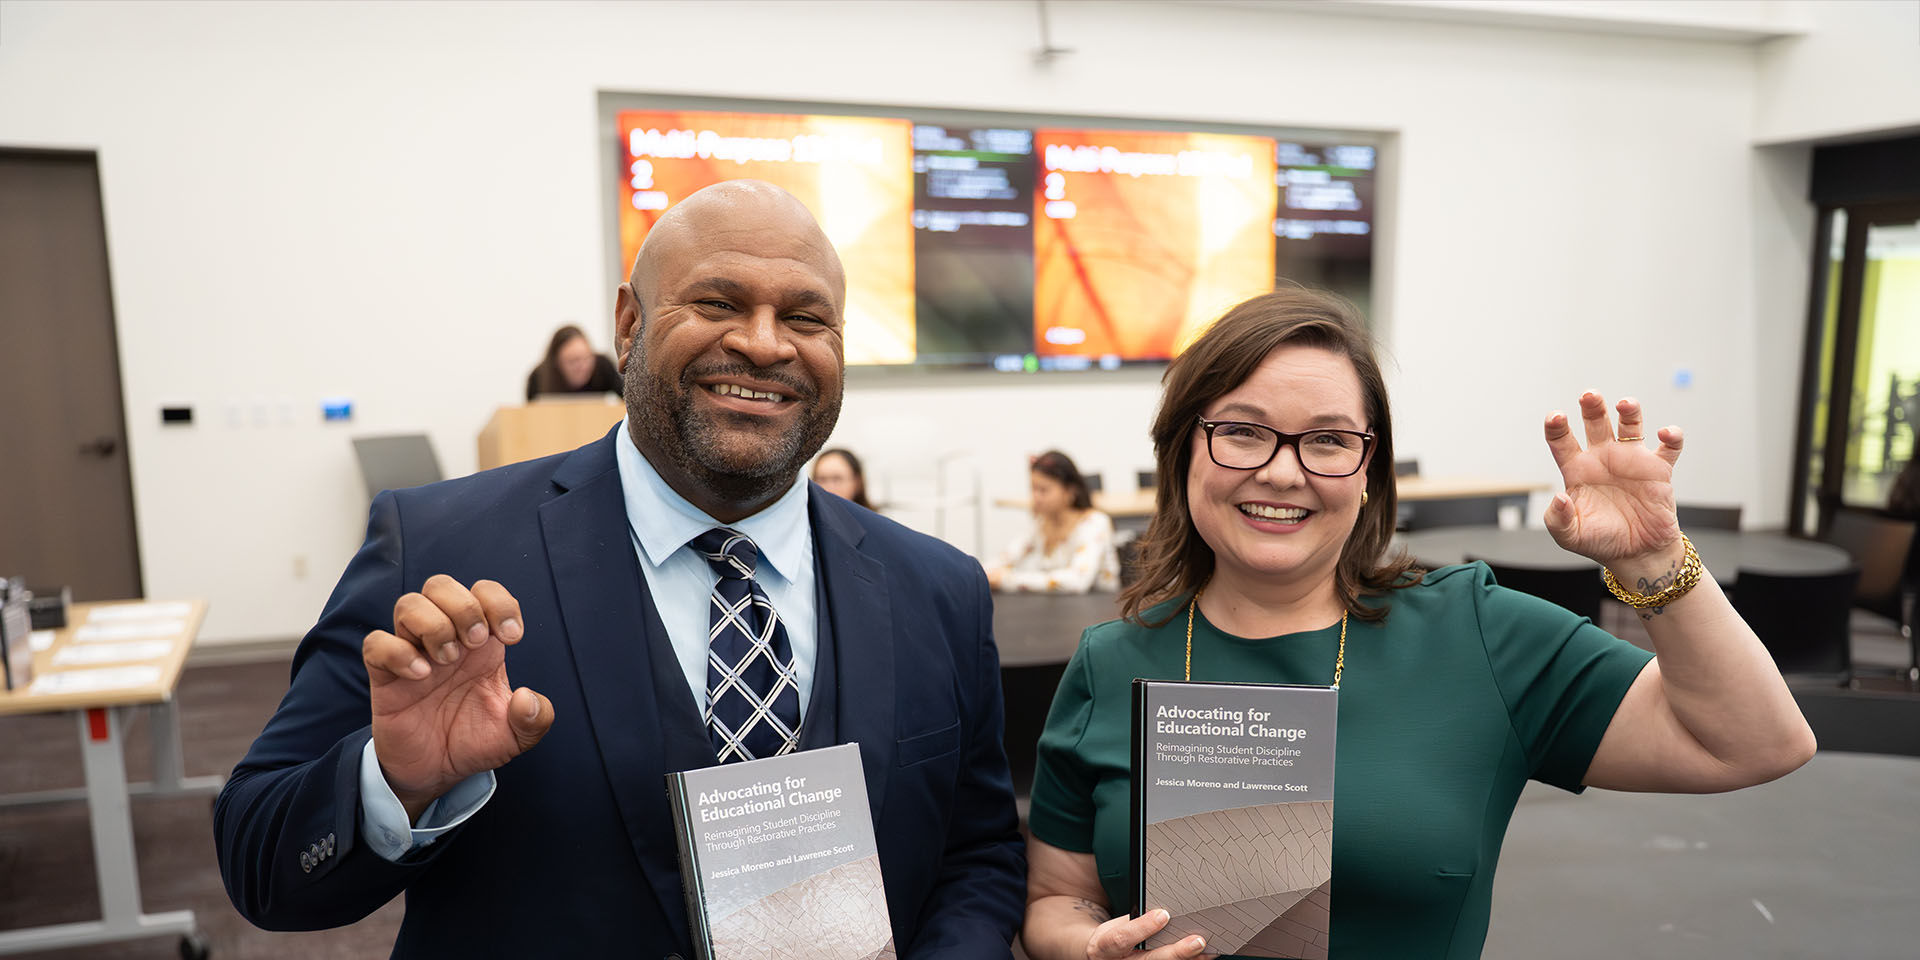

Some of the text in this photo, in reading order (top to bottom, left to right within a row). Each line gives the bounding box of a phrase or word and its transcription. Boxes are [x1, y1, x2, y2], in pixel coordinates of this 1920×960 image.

[1156, 705, 1271, 725] Advocating for
[1157, 721, 1307, 742] Educational Change
[1156, 742, 1301, 758] Reimagining Student Discipline
[1156, 752, 1293, 766] Through Restorative Practices
[698, 776, 806, 806] Advocating for
[1155, 778, 1308, 792] Jessica Moreno and Lawrence Scott
[701, 788, 842, 822] Educational Change
[704, 810, 840, 842] Reimagining Student Discipline
[706, 821, 836, 852] Through Restorative Practices
[711, 844, 854, 879] Jessica Moreno and Lawrence Scott
